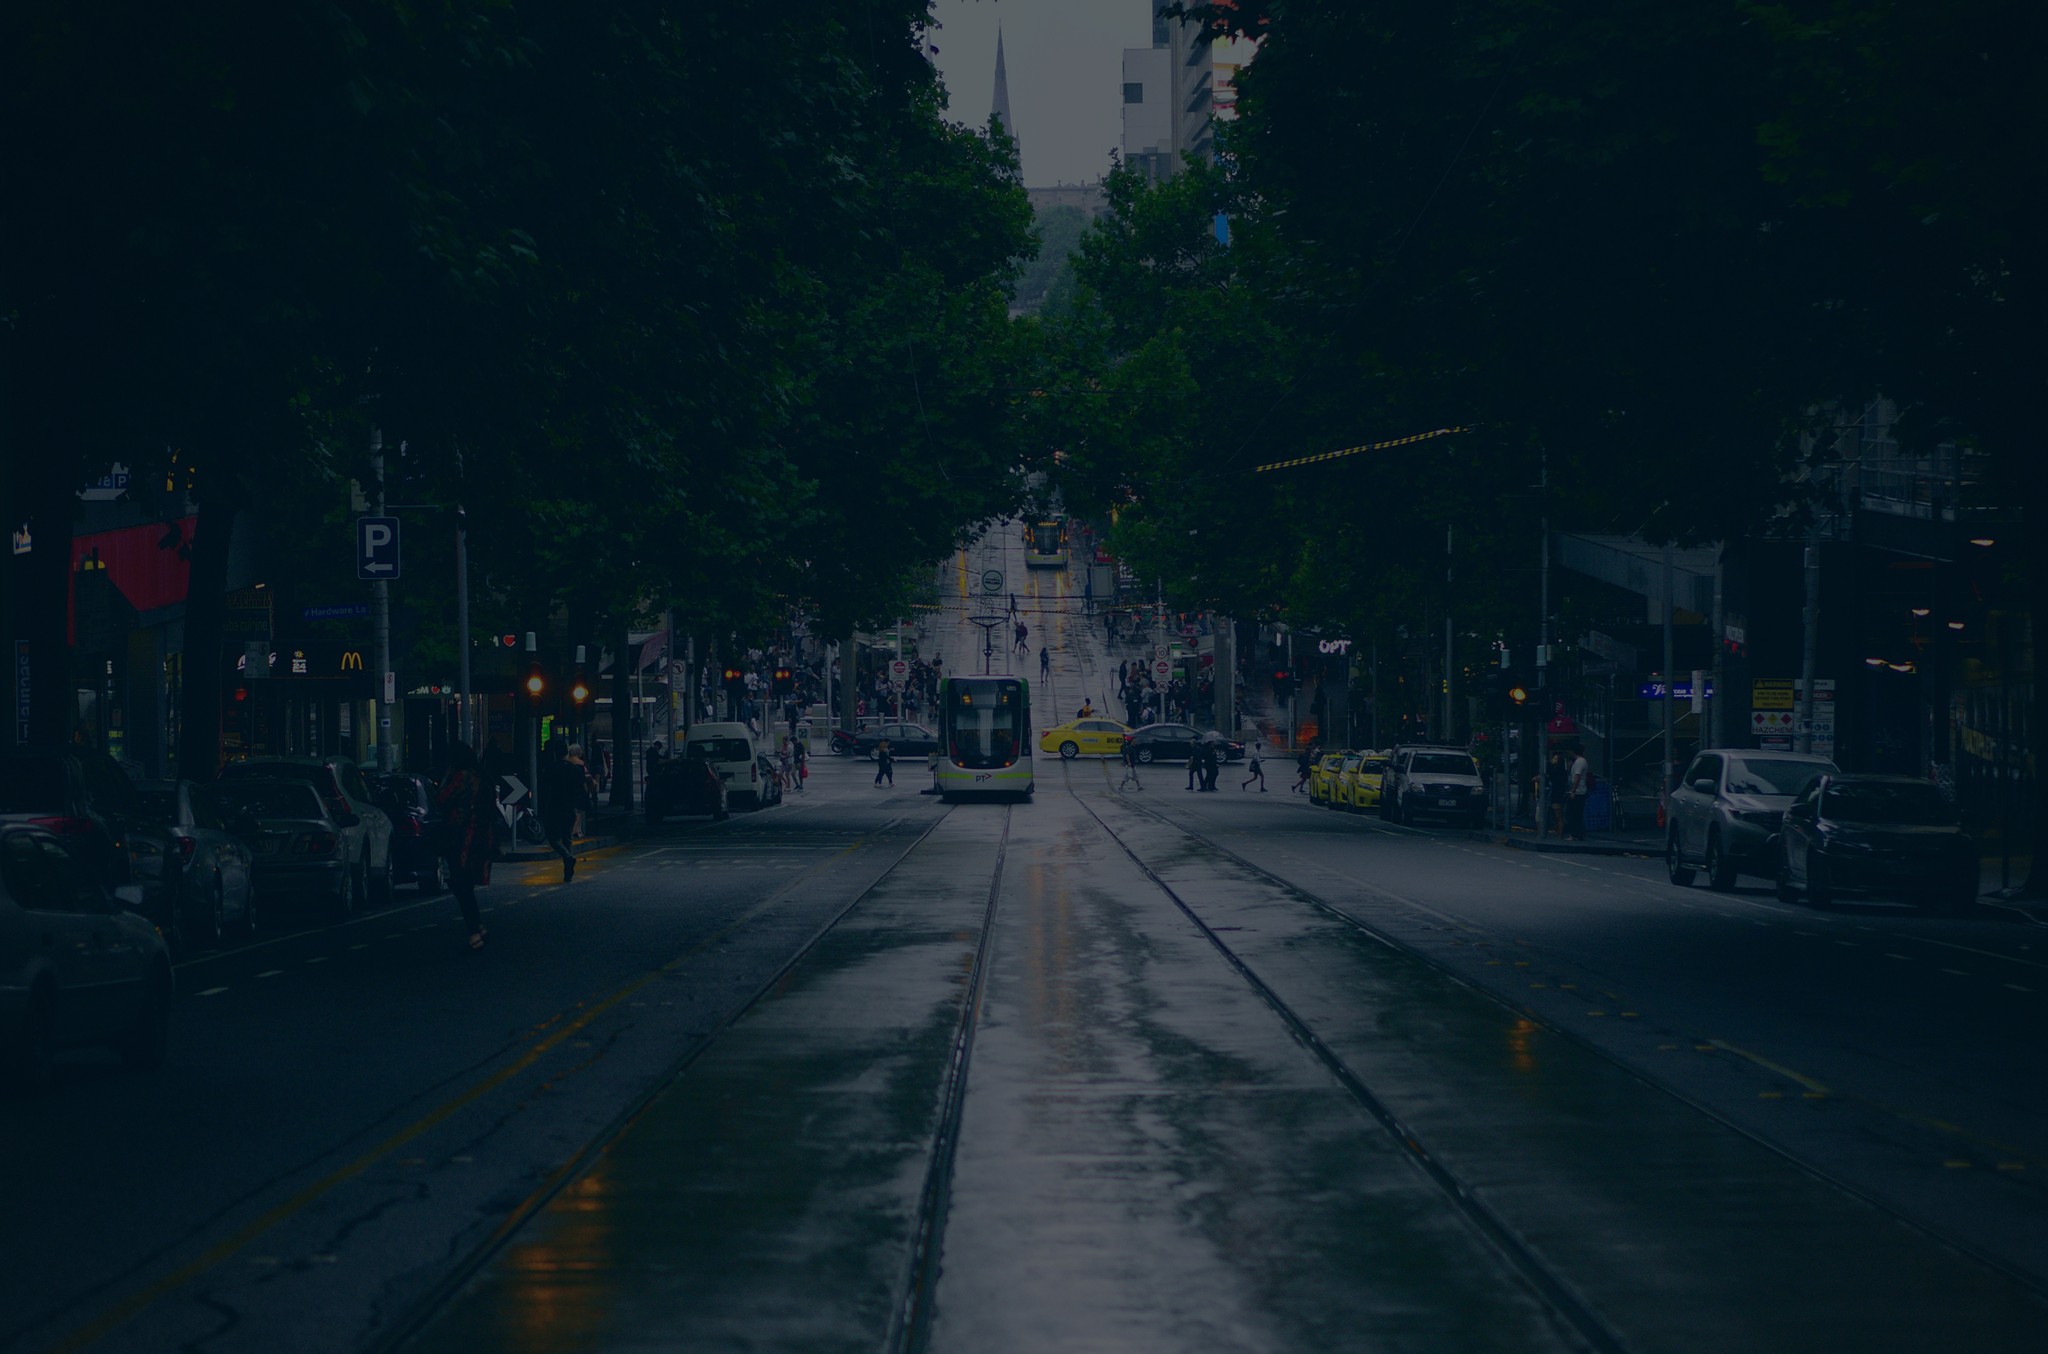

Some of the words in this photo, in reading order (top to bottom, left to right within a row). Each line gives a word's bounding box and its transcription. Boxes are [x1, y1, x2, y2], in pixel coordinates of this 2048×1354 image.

[365, 524, 392, 558] P
[311, 608, 353, 616] Hardware
[355, 605, 366, 613] La
